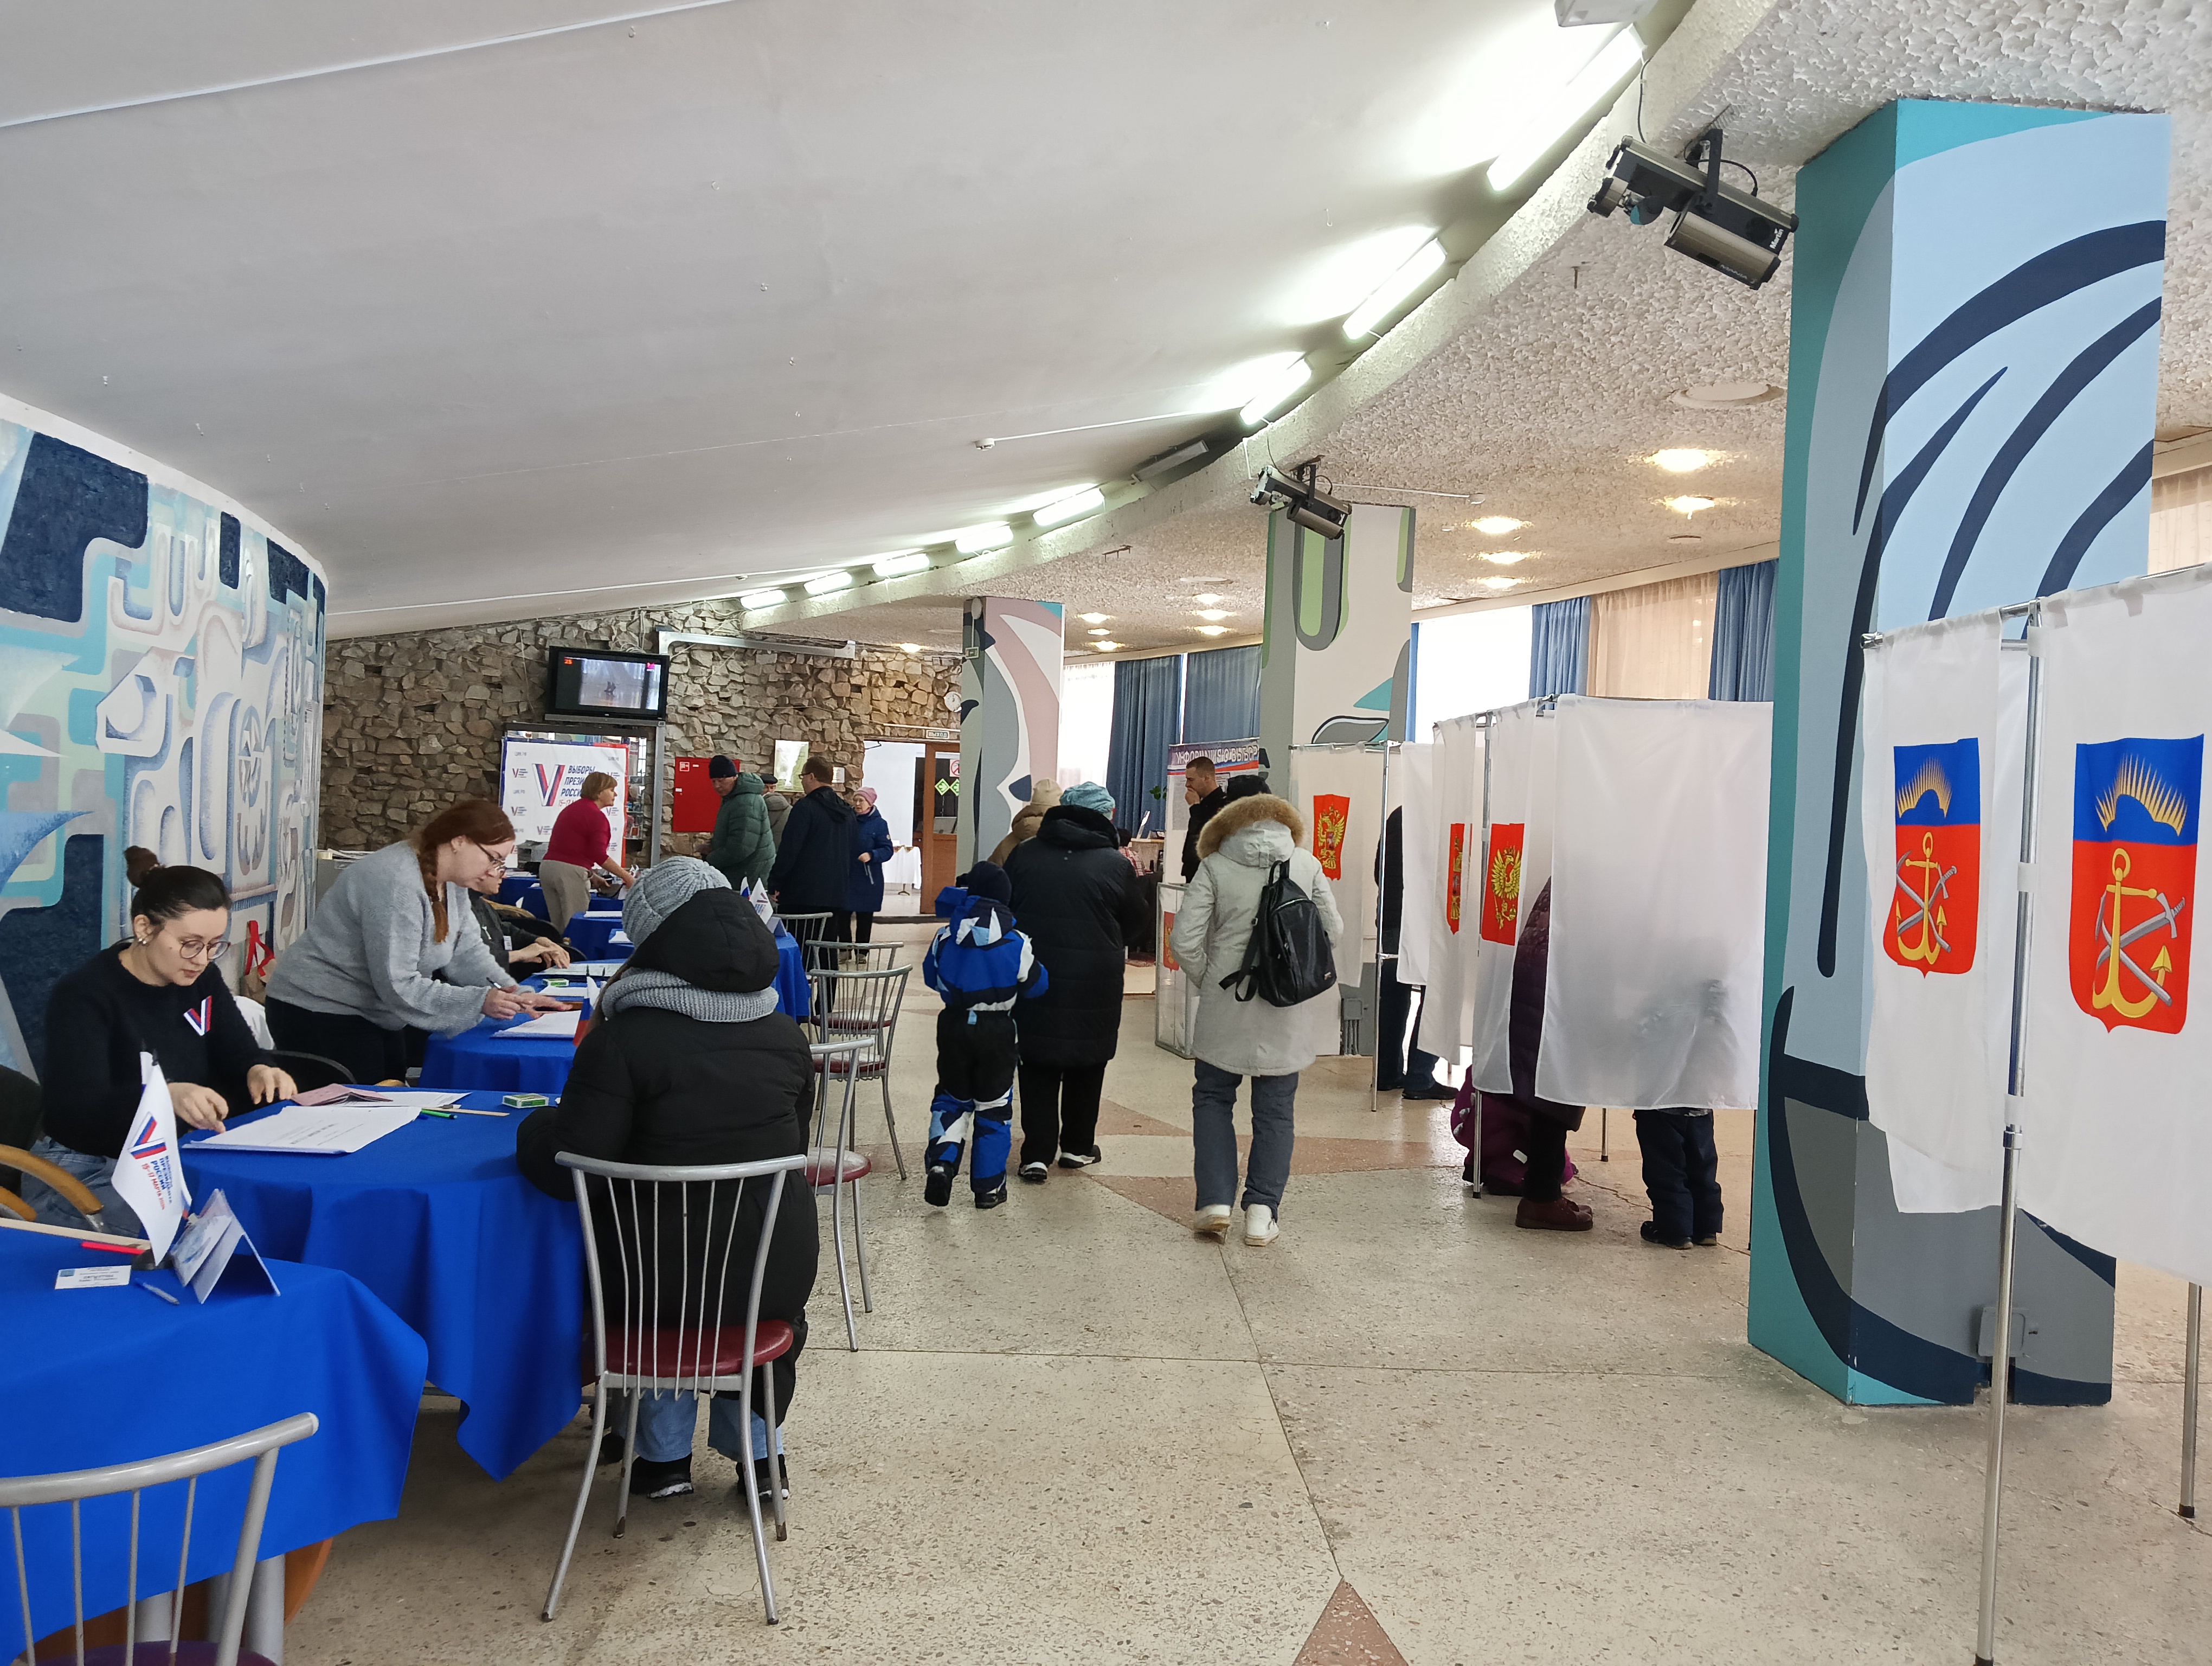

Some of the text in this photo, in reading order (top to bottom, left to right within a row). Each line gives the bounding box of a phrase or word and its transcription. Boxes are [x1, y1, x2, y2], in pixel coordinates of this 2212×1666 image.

[568, 765, 595, 774] ВЫБОРЫ
[564, 777, 585, 785] ПРЕЗИ
[561, 788, 582, 797] РОССИ
